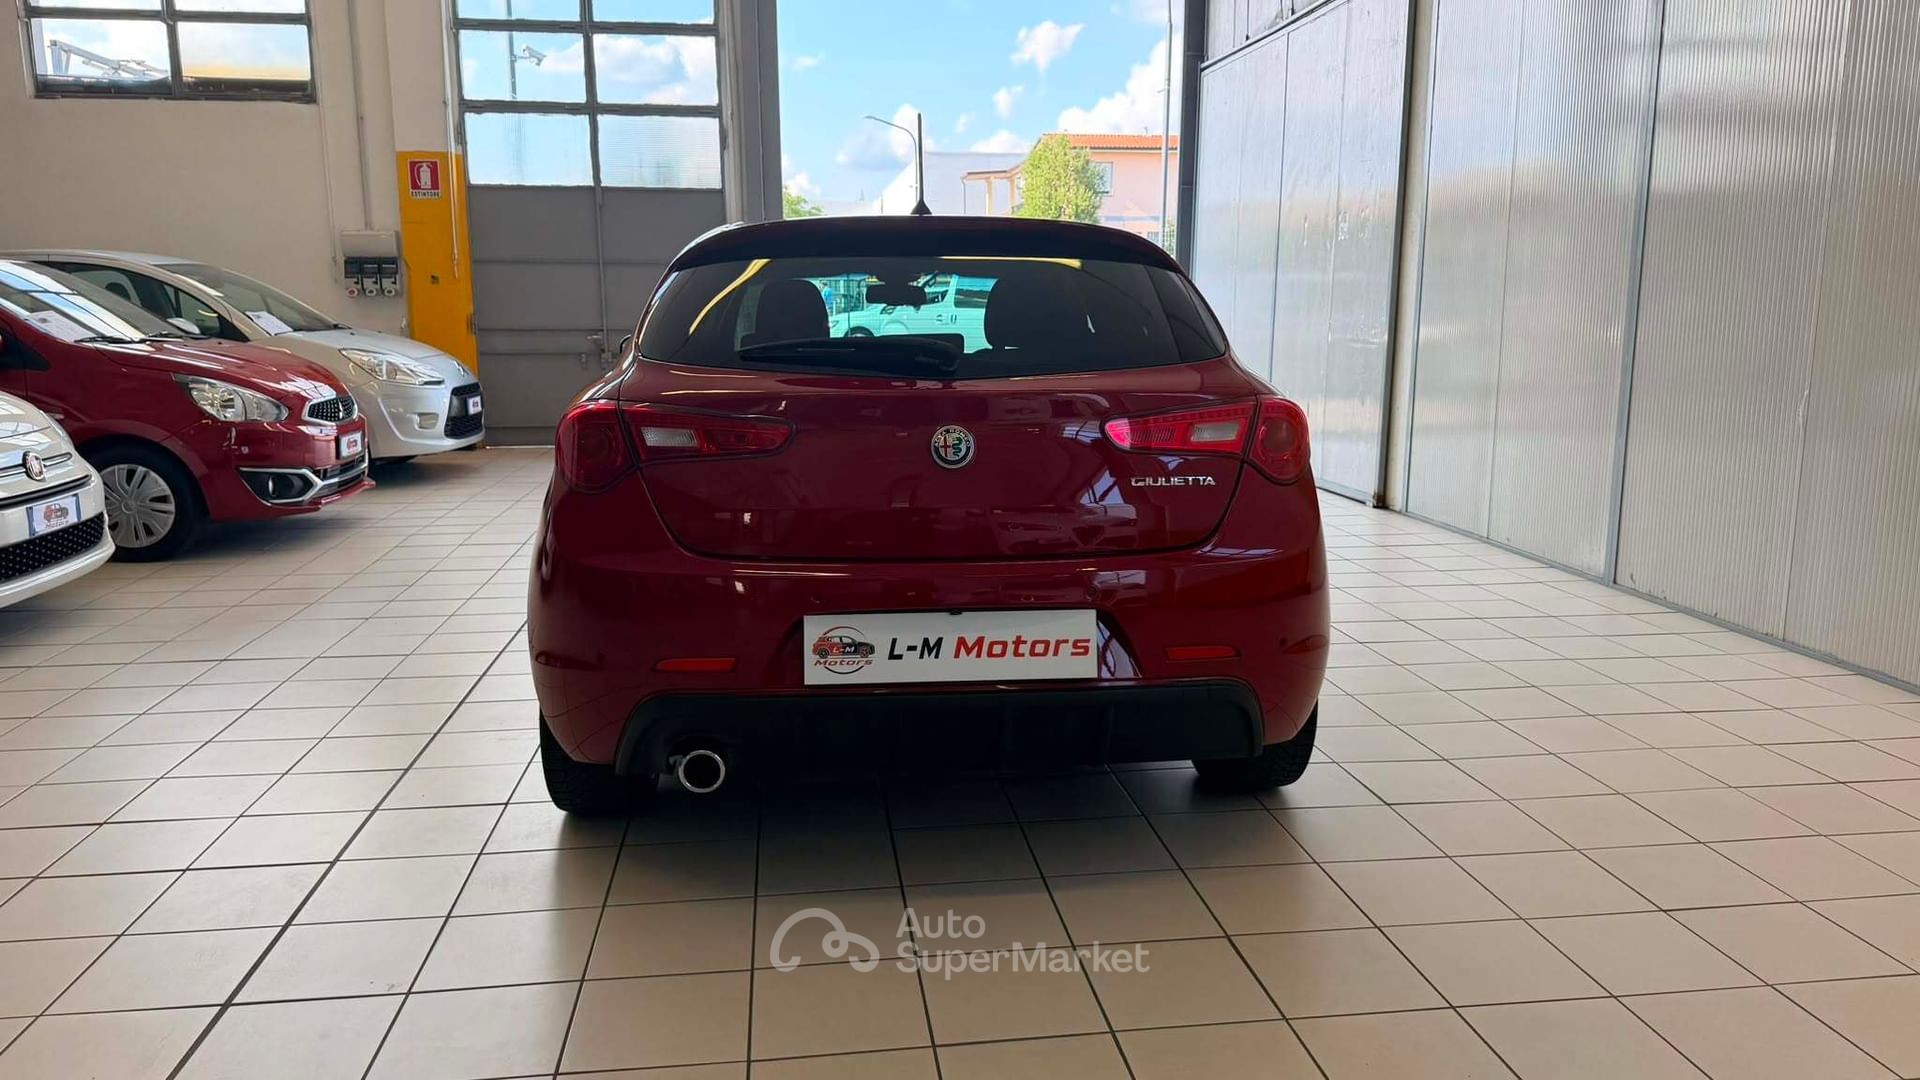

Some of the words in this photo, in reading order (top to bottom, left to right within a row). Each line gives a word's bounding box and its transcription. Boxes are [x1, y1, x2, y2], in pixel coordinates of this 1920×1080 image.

[1130, 476, 1216, 487] GIULIETTA
[832, 645, 855, 653] L-M
[888, 637, 944, 660] L-M
[953, 635, 1091, 659] Motors
[814, 659, 873, 667] Motors
